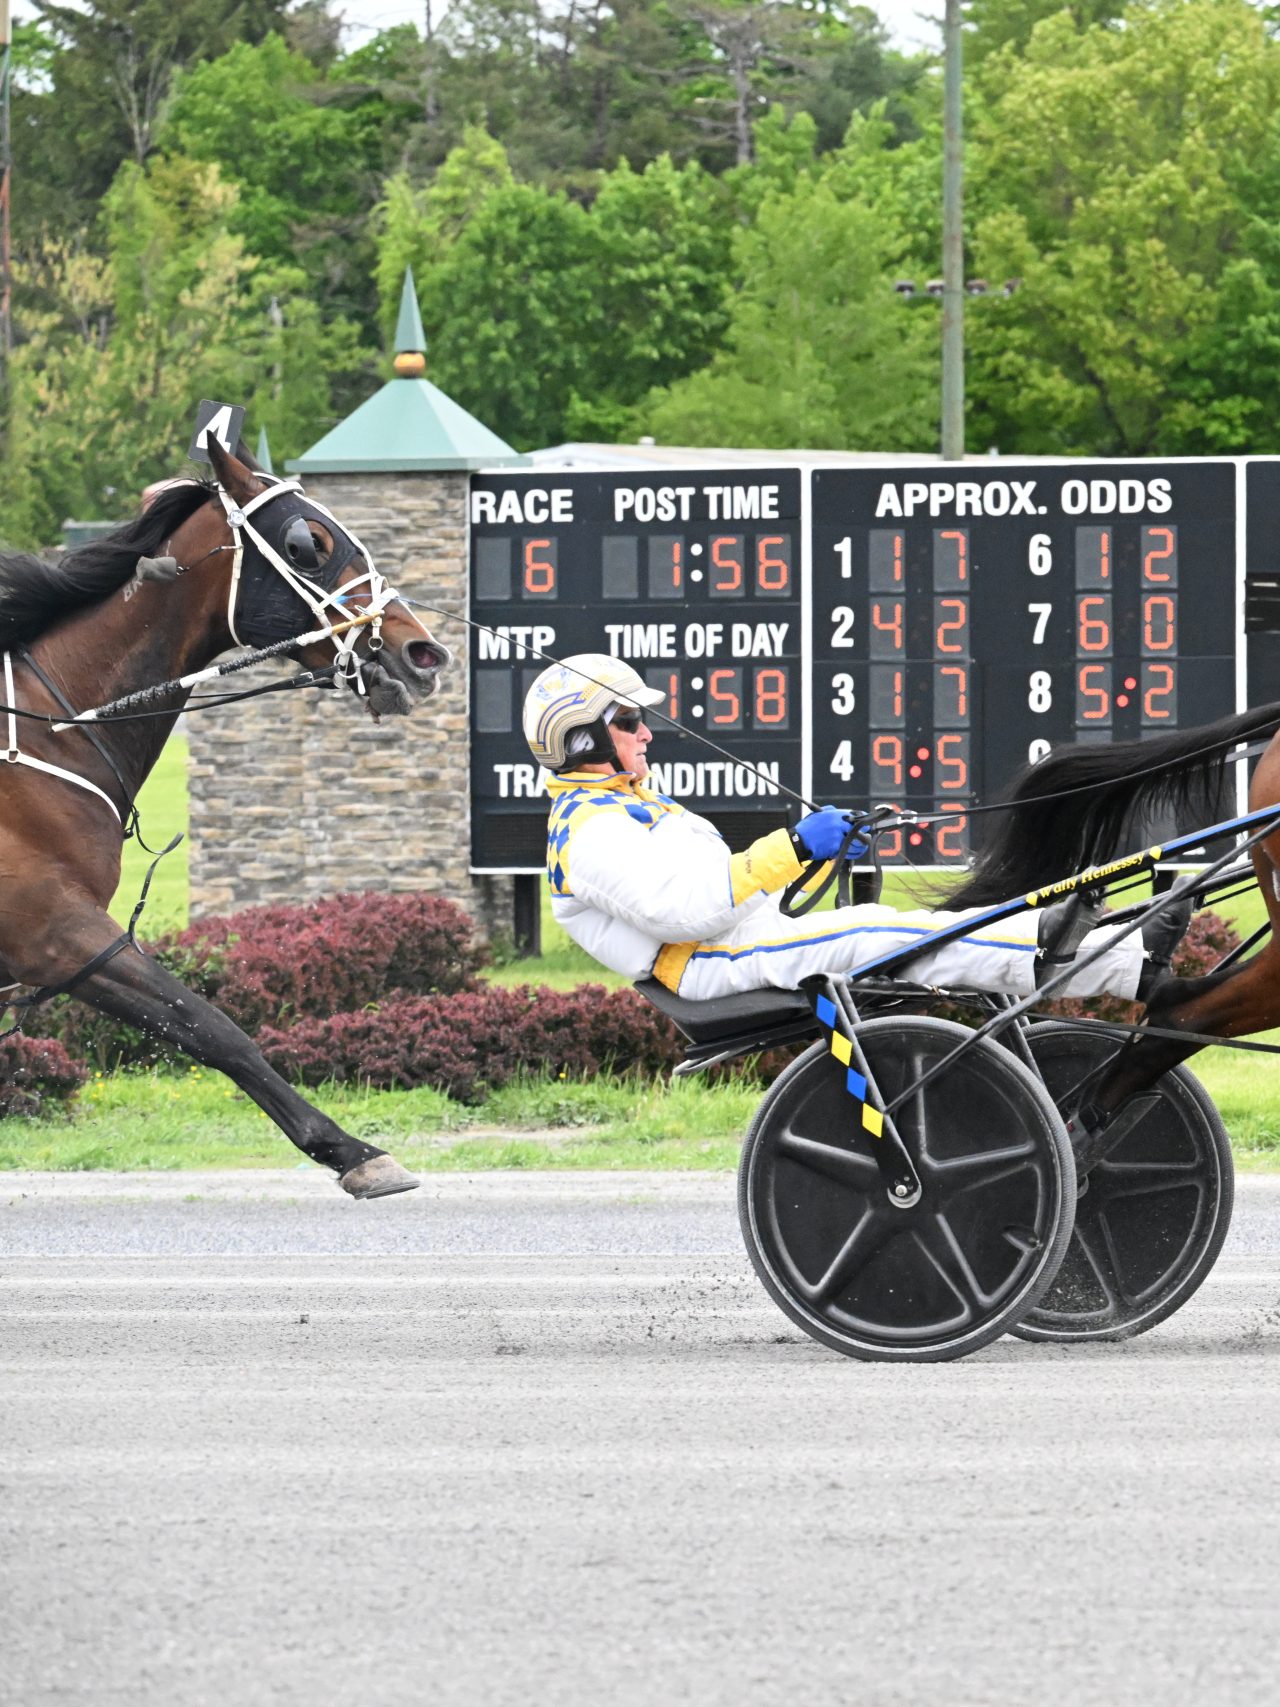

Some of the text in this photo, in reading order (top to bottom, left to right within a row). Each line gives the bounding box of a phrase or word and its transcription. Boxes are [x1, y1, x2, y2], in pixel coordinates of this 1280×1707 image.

[196, 404, 232, 453] 4
[472, 489, 573, 523] RACE
[615, 486, 779, 522] POST TIME
[875, 479, 1172, 517] APPROX. ODDS
[525, 540, 554, 592] 6
[673, 537, 787, 589] 1:56
[834, 537, 851, 578] 1
[1029, 534, 1052, 575] 6
[478, 626, 556, 660] MTP
[604, 623, 789, 658] TIME OF DAY
[831, 606, 854, 647] 2
[1029, 603, 1051, 644] 7
[669, 670, 785, 723] 1:58
[832, 673, 854, 715] 3
[1029, 671, 1051, 713] 8
[830, 741, 853, 781] 4
[1038, 851, 1145, 899] Wally Hennessey
